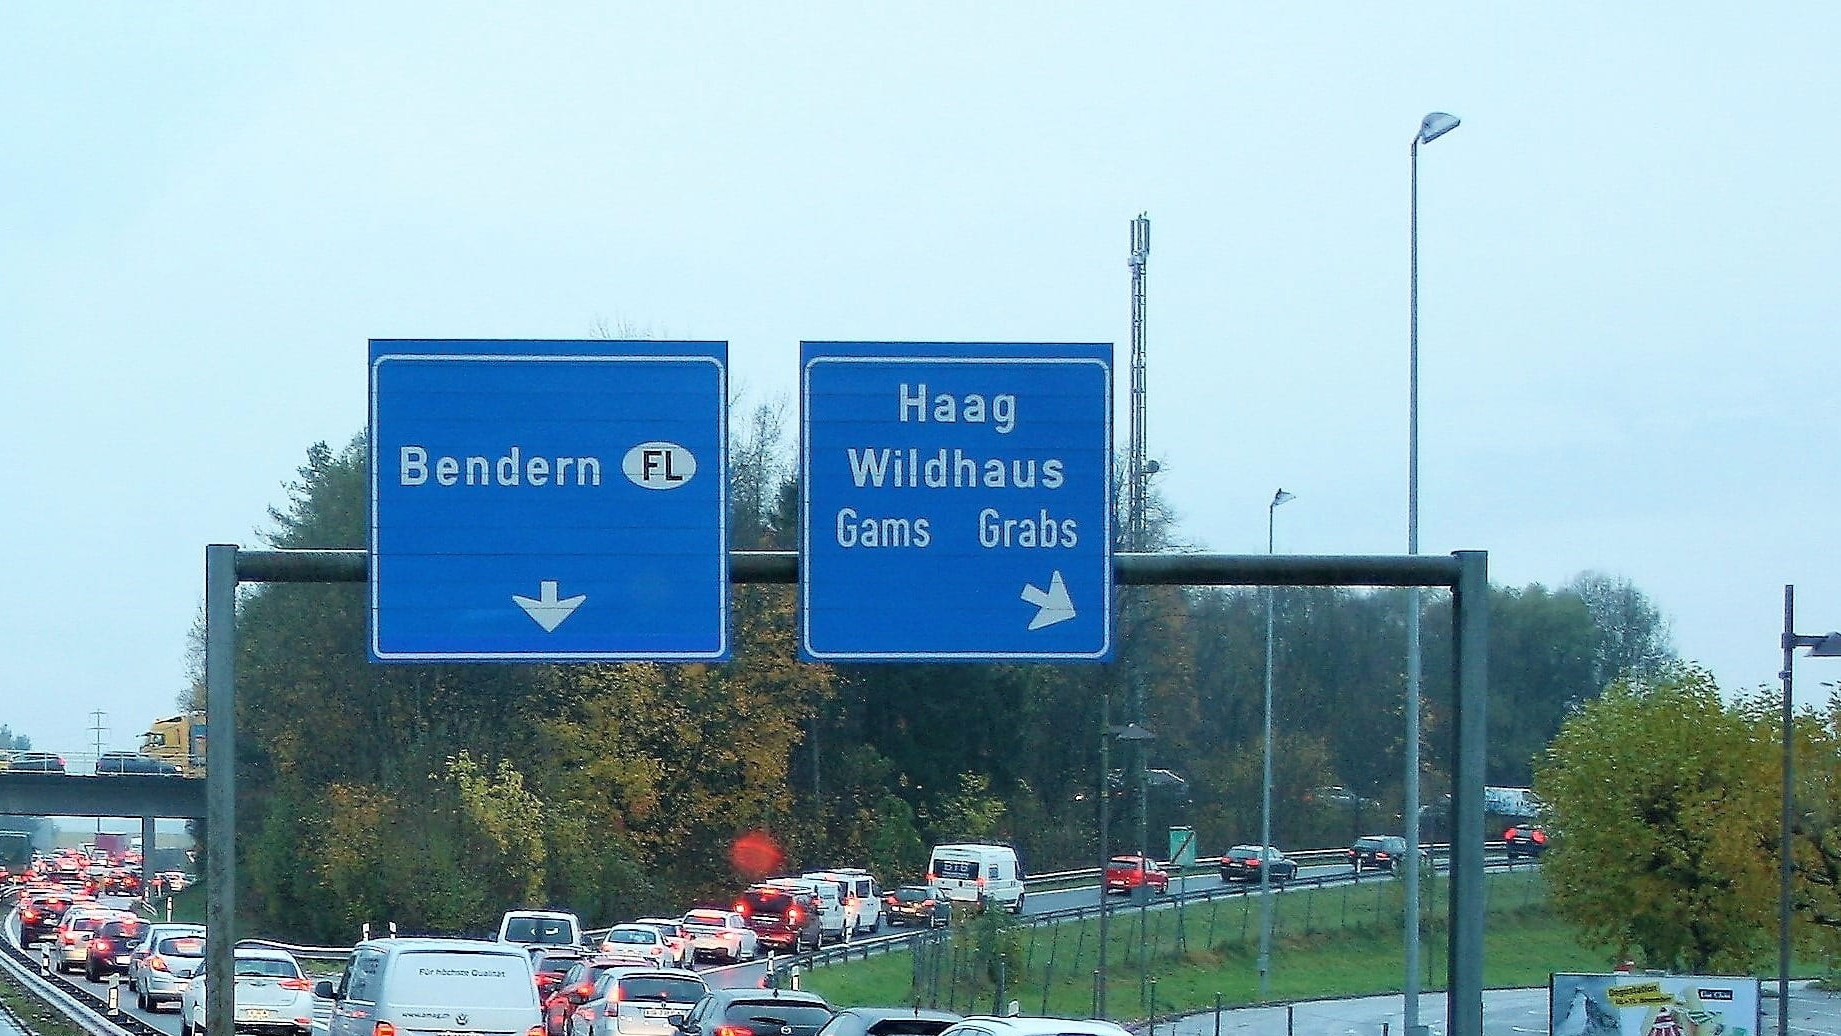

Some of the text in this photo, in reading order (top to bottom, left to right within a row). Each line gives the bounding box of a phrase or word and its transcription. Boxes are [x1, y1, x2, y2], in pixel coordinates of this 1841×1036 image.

[899, 383, 1016, 434] Haag
[399, 446, 684, 487] Bendern FL
[847, 448, 1064, 488] Wildhaus
[836, 508, 1079, 549] Gams Grabs
